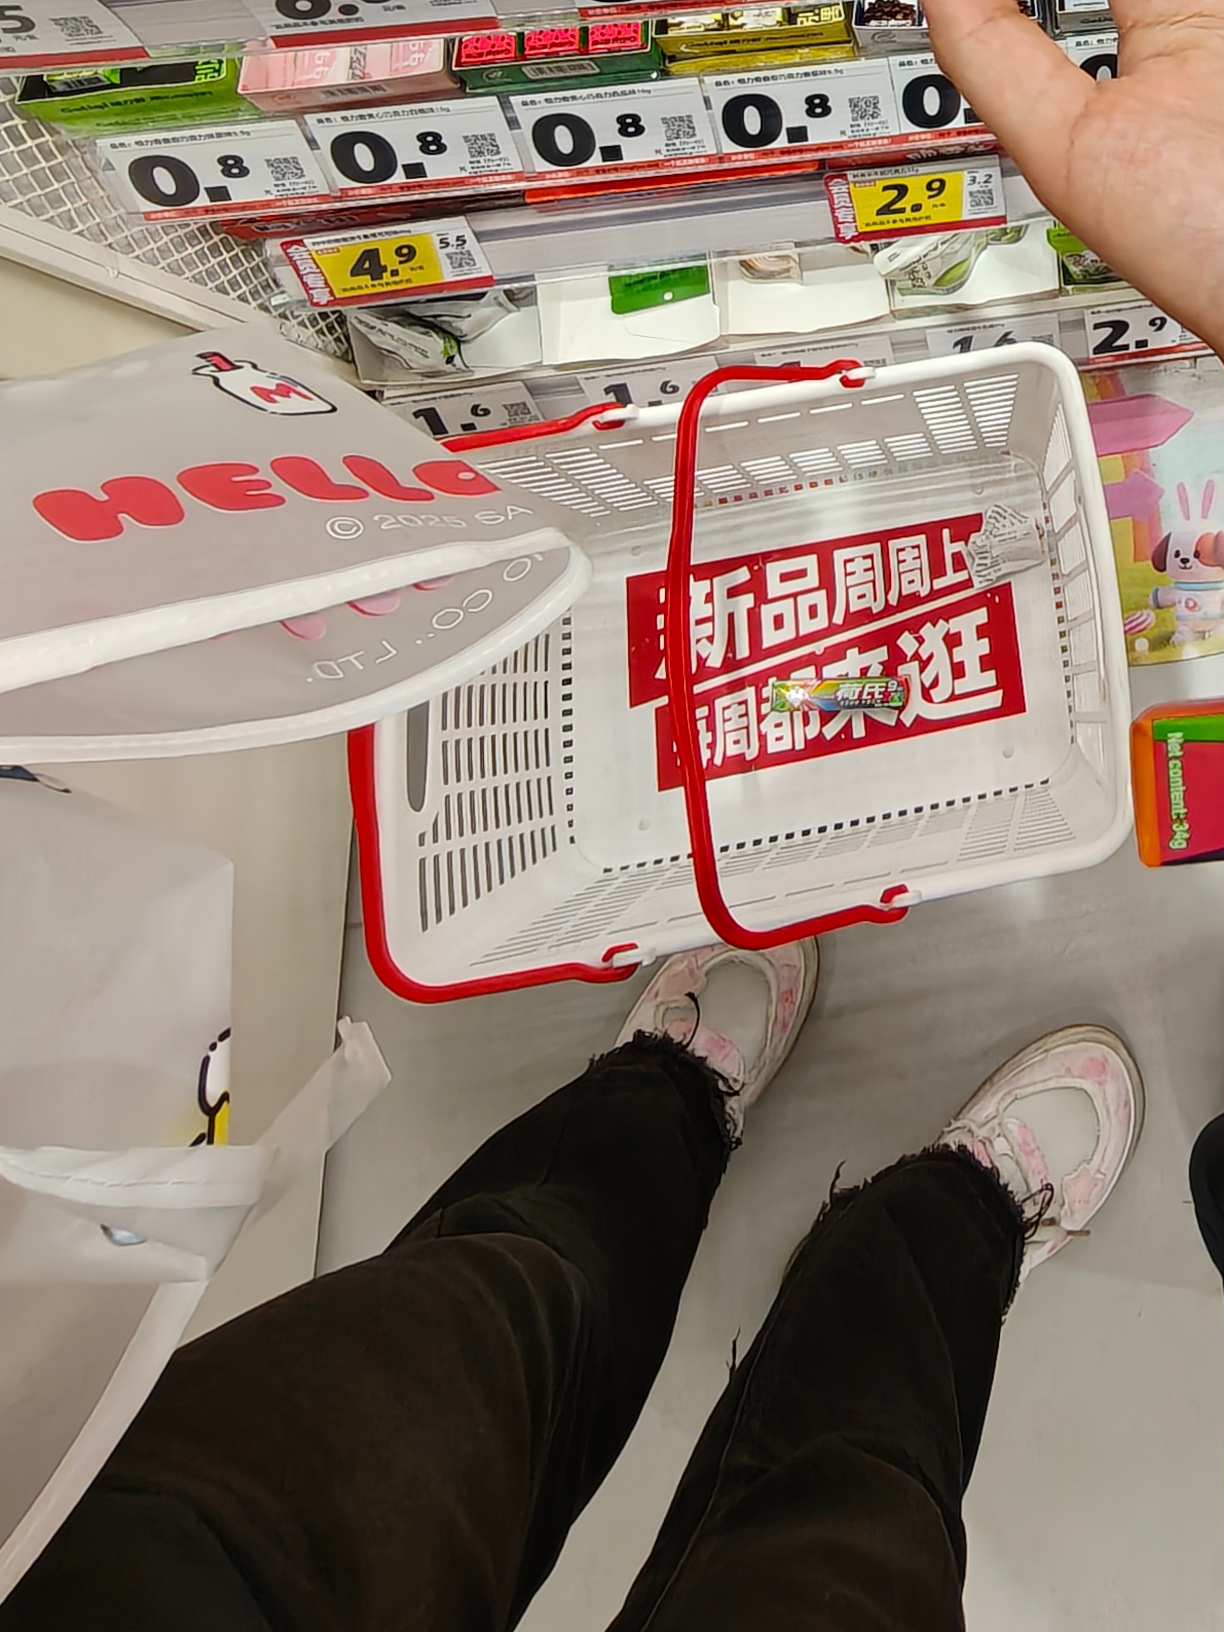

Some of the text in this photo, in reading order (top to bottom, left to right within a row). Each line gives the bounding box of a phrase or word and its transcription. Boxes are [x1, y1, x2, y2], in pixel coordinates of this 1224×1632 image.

[530, 111, 645, 167] 0.8
[720, 93, 832, 149] 0.8
[329, 130, 448, 184] 0.8
[128, 153, 252, 207] 0.8
[874, 177, 946, 217] 2.9
[966, 173, 994, 187] 3.2
[350, 243, 418, 281] 4.9
[439, 235, 468, 250] 5.5
[1091, 315, 1168, 356] 2.9
[412, 403, 493, 439] 1.6
[32, 454, 500, 542] HELLO
[372, 510, 466, 531] 2025
